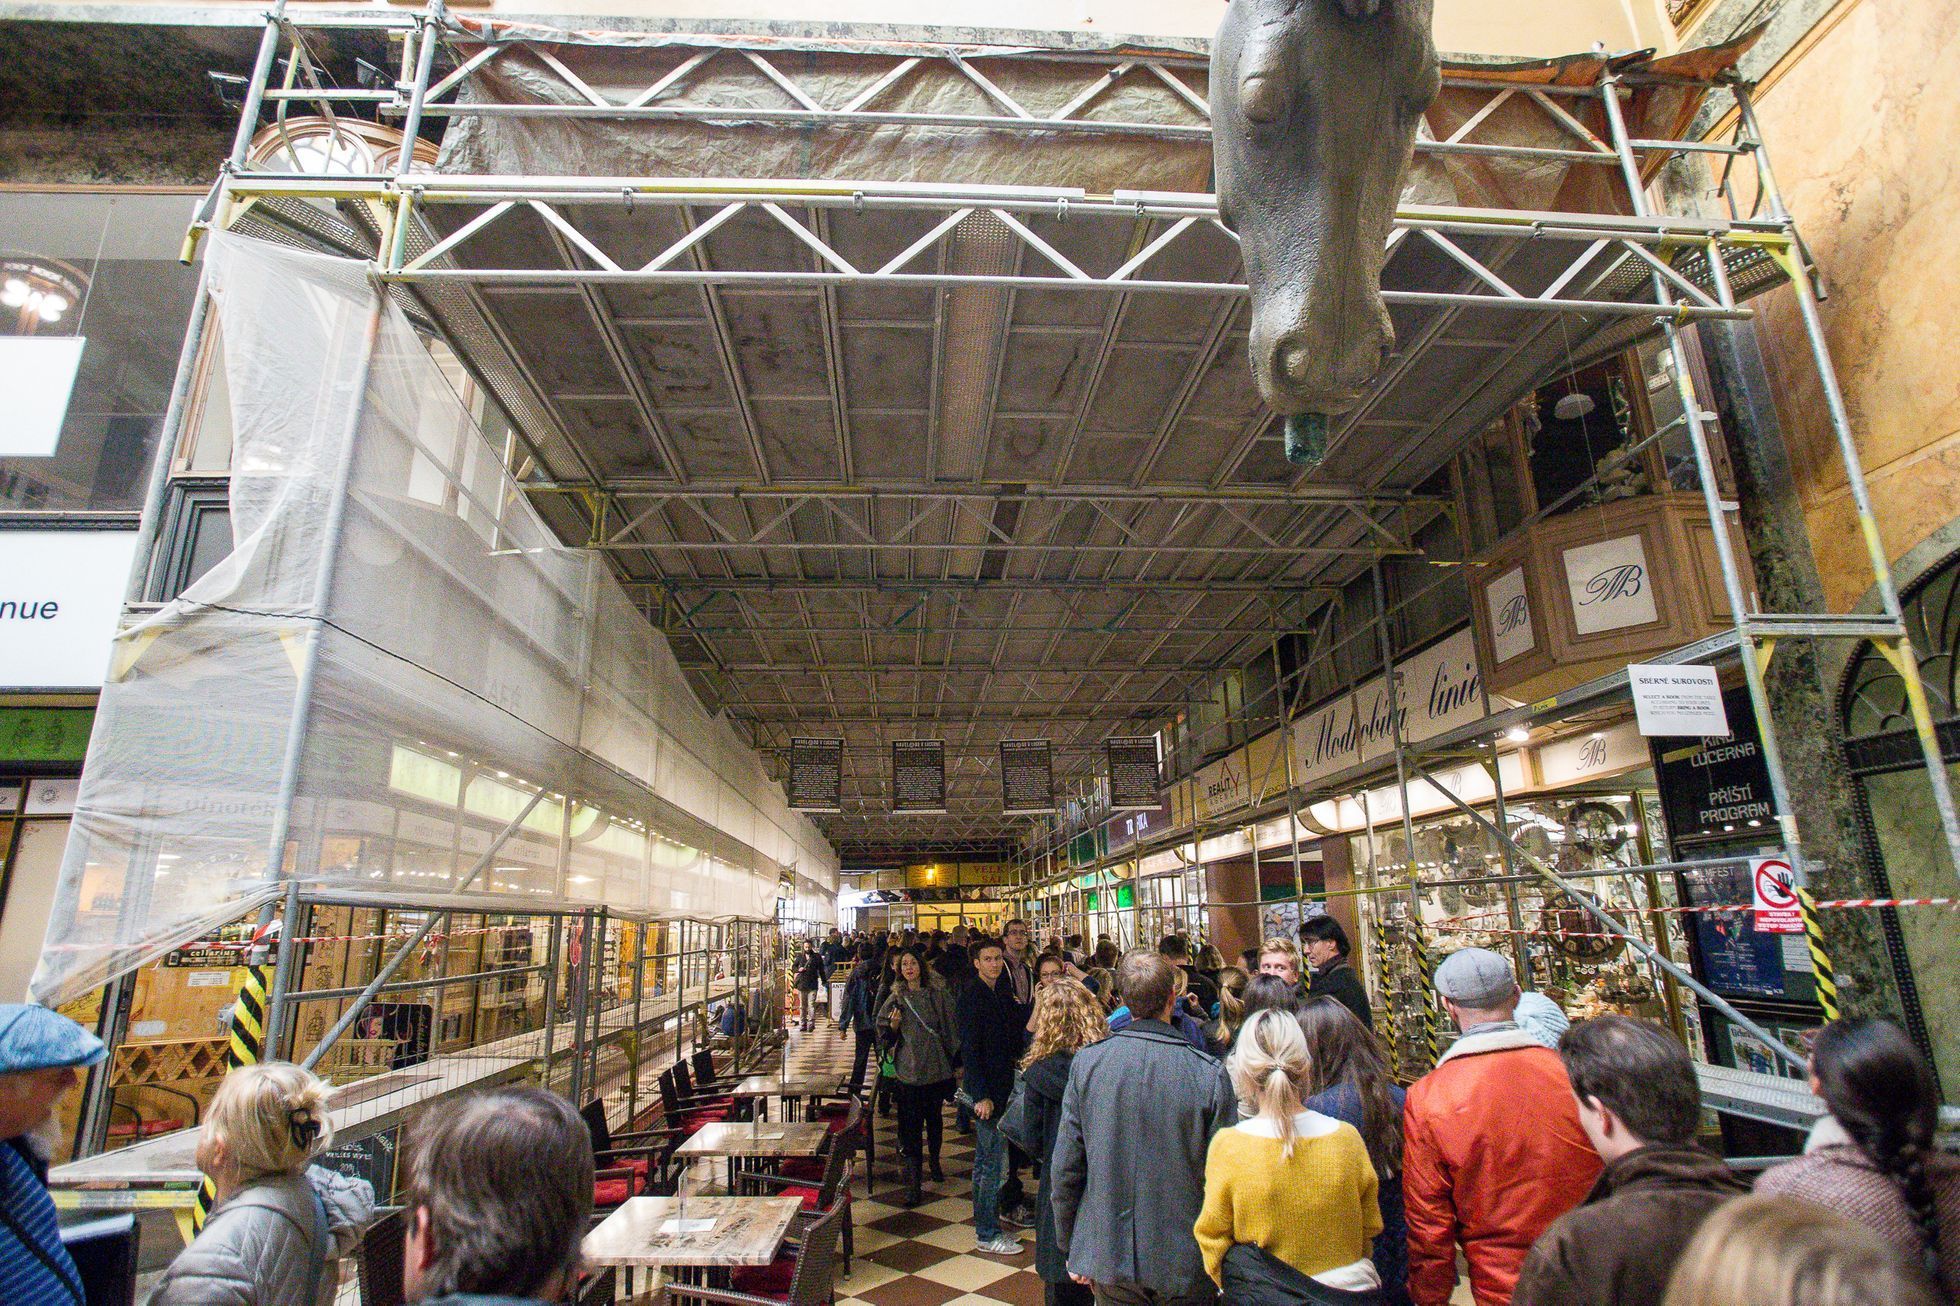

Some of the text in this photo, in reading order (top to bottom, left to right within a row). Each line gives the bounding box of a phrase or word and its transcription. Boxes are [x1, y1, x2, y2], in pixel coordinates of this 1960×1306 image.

[1429, 661, 1481, 719] linie
[1691, 742, 1756, 768] LUCERNA
[1709, 783, 1753, 805] PŘÍŠTÍ
[1700, 802, 1770, 823] PROGRAM
